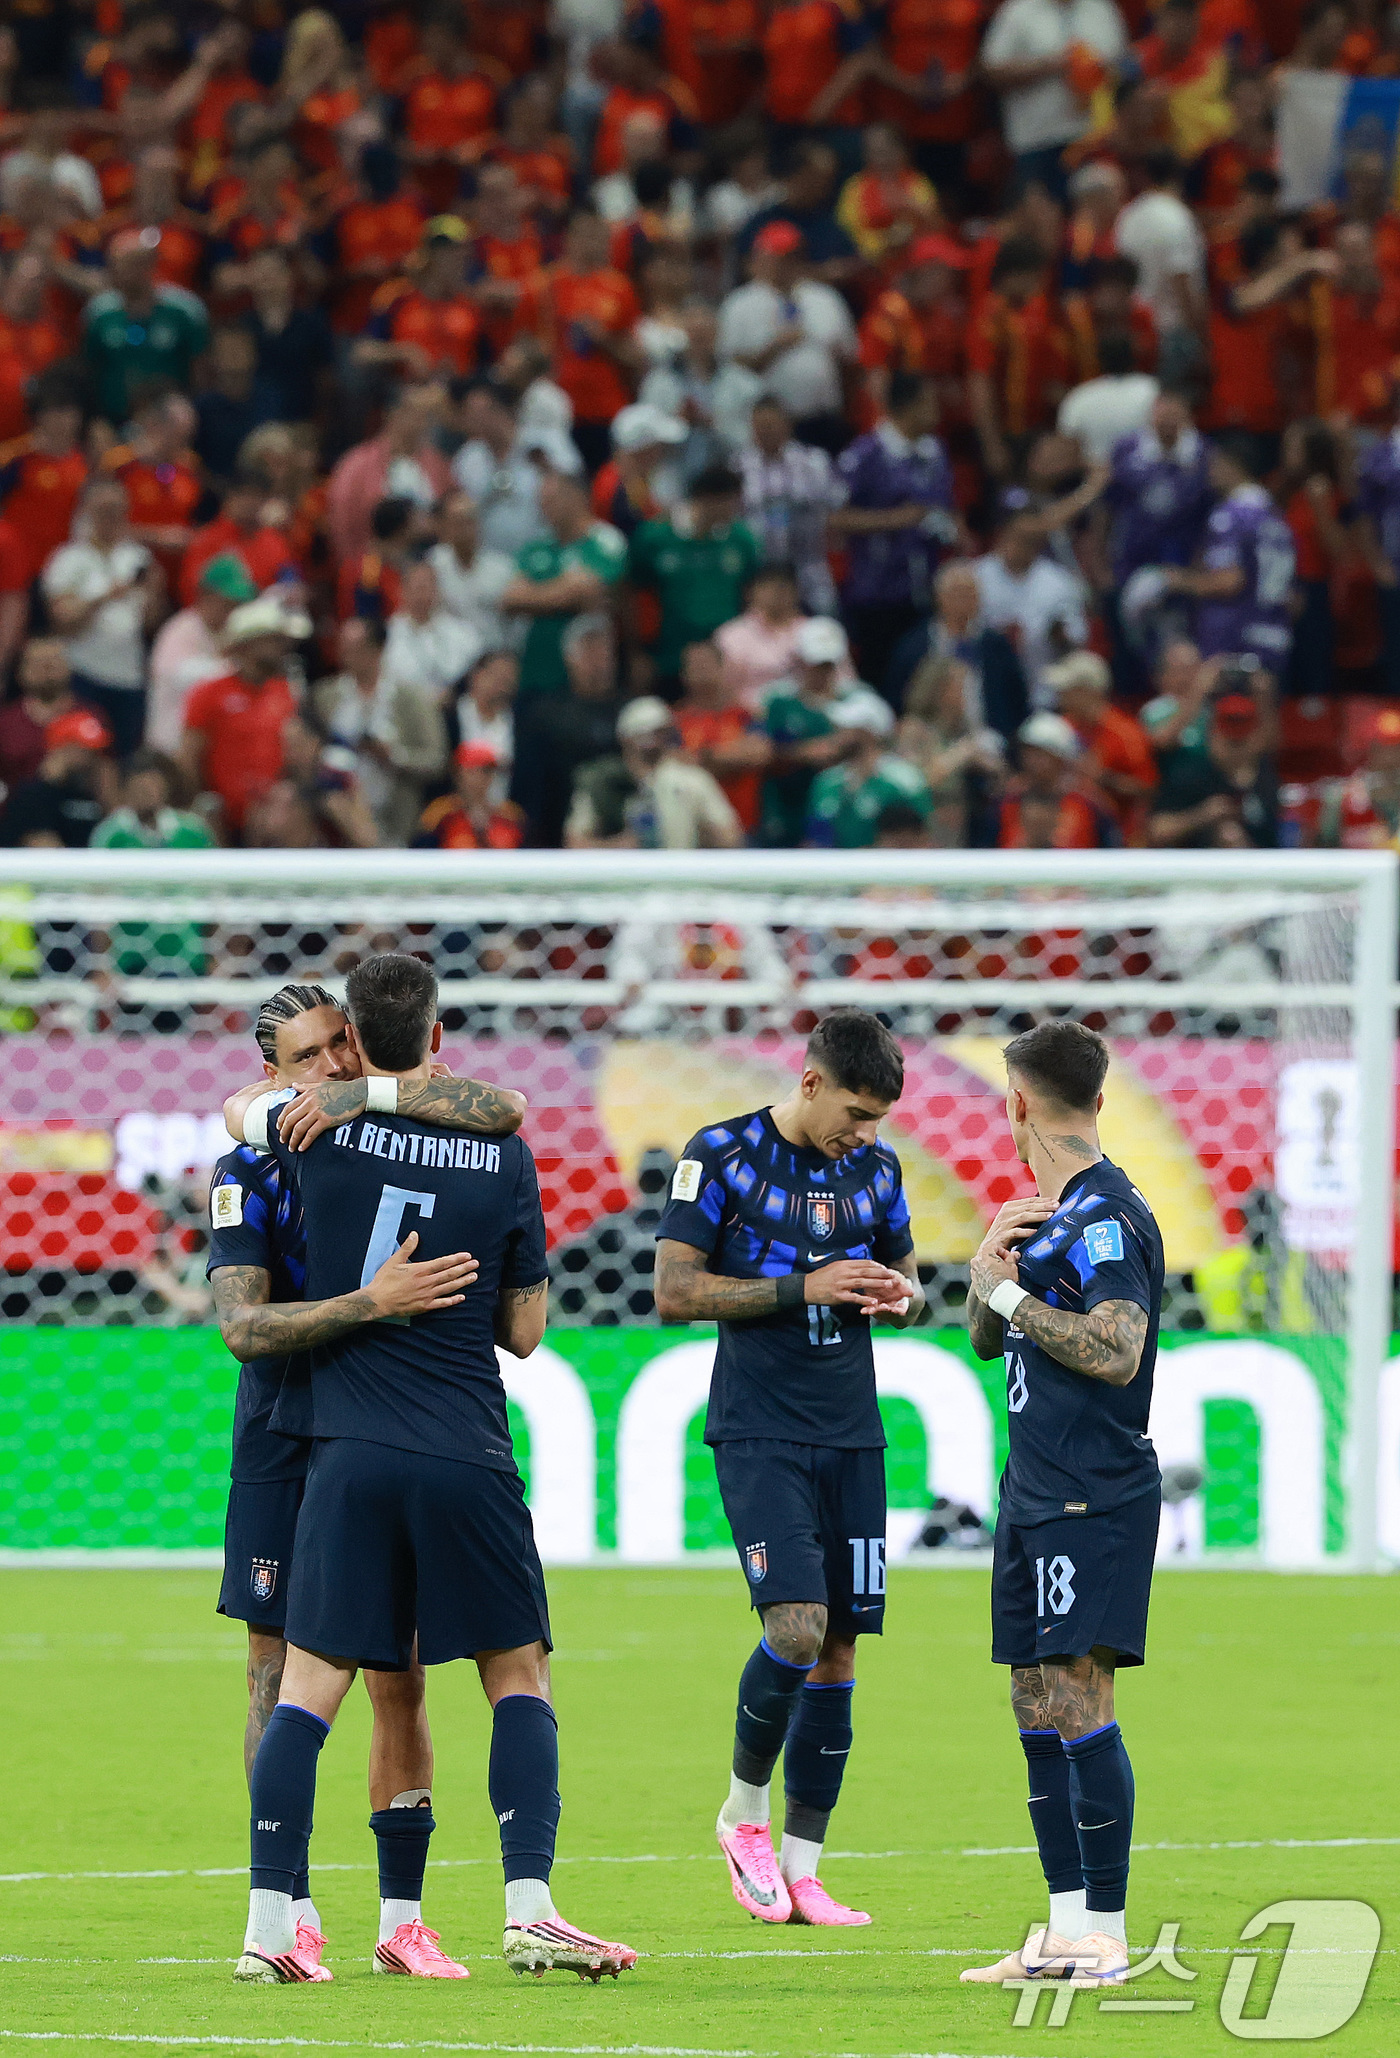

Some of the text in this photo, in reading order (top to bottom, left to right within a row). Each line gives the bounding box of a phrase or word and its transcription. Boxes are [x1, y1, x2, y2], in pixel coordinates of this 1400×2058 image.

[848, 1537, 887, 1595] 16
[1035, 1555, 1077, 1617] 18
[257, 1819, 282, 1832] AUF
